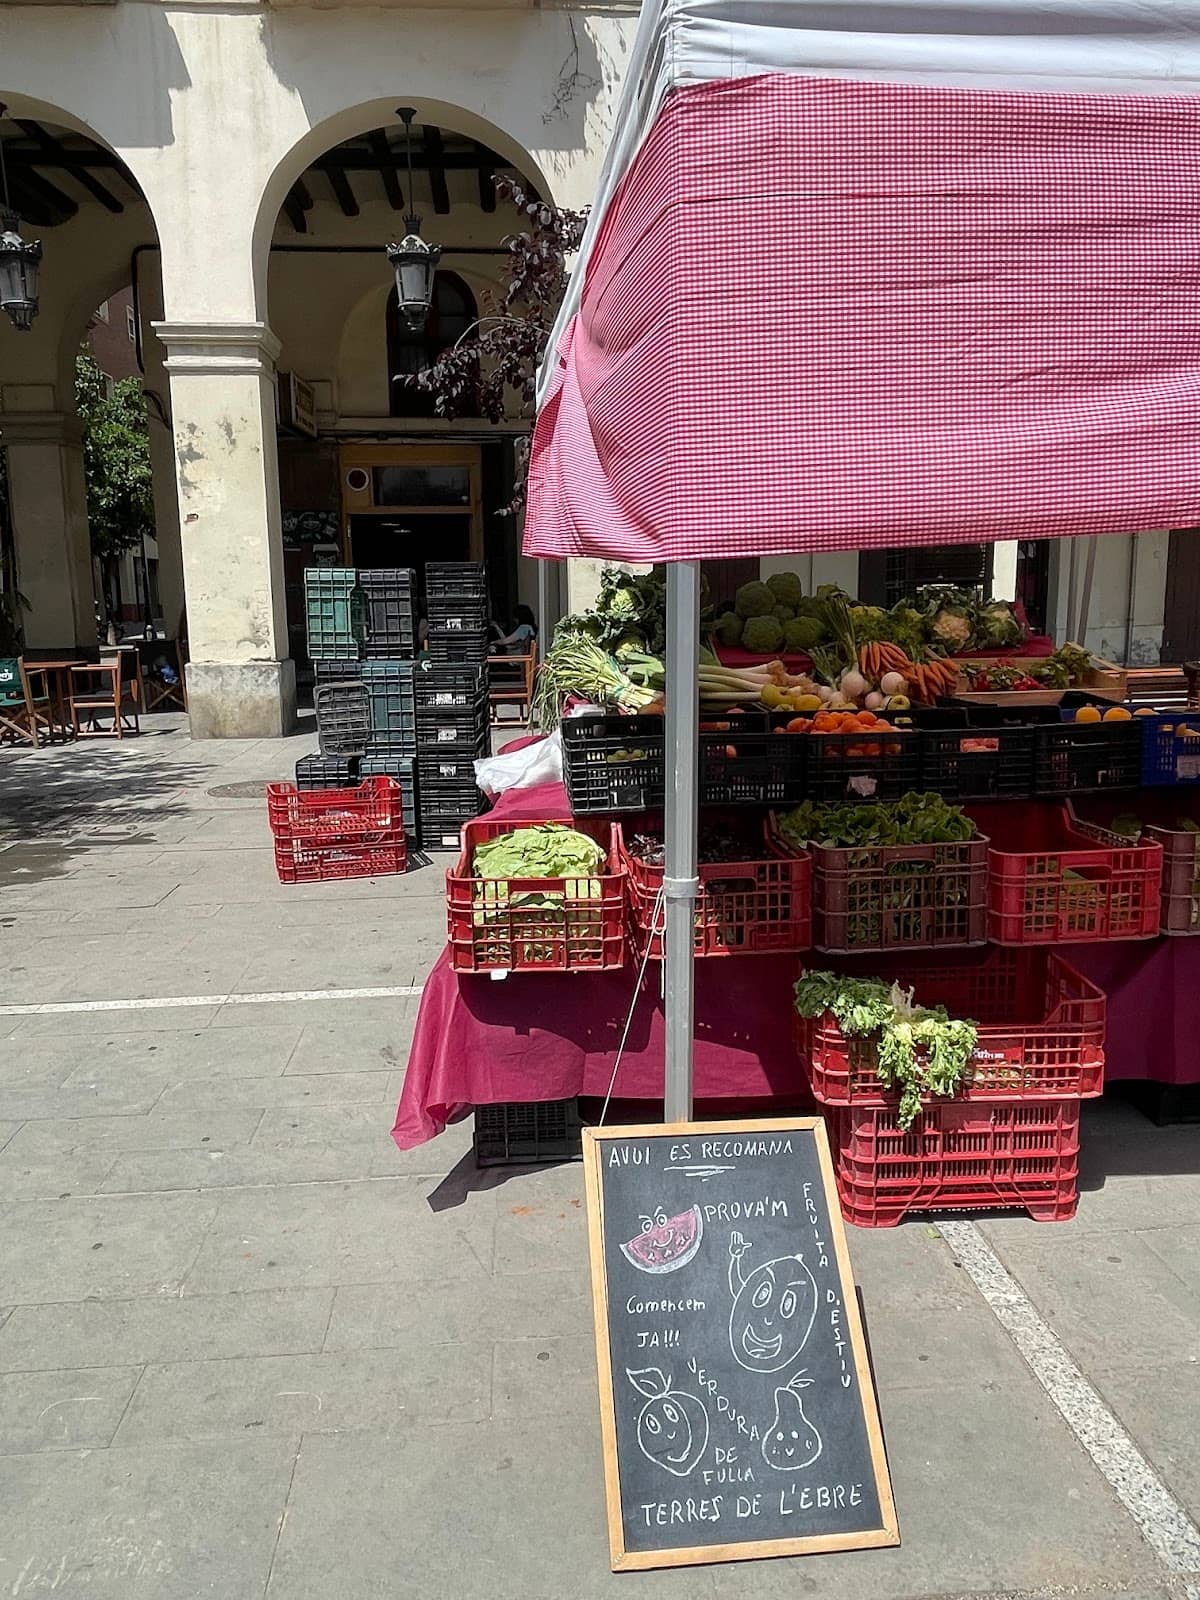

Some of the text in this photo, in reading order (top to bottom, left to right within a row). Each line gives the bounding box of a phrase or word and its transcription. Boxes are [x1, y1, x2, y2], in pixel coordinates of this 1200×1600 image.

[608, 1140, 793, 1168] AVUI ES RECOMANA
[703, 1196, 788, 1223] PROVA'M
[803, 1182, 829, 1267] FRUITA
[626, 1295, 706, 1314] Comencem
[687, 1356, 760, 1441] VERDURA
[715, 1446, 739, 1465] DE
[702, 1467, 756, 1486] FULLA
[640, 1483, 863, 1527] TERRES DE L'EBRE
